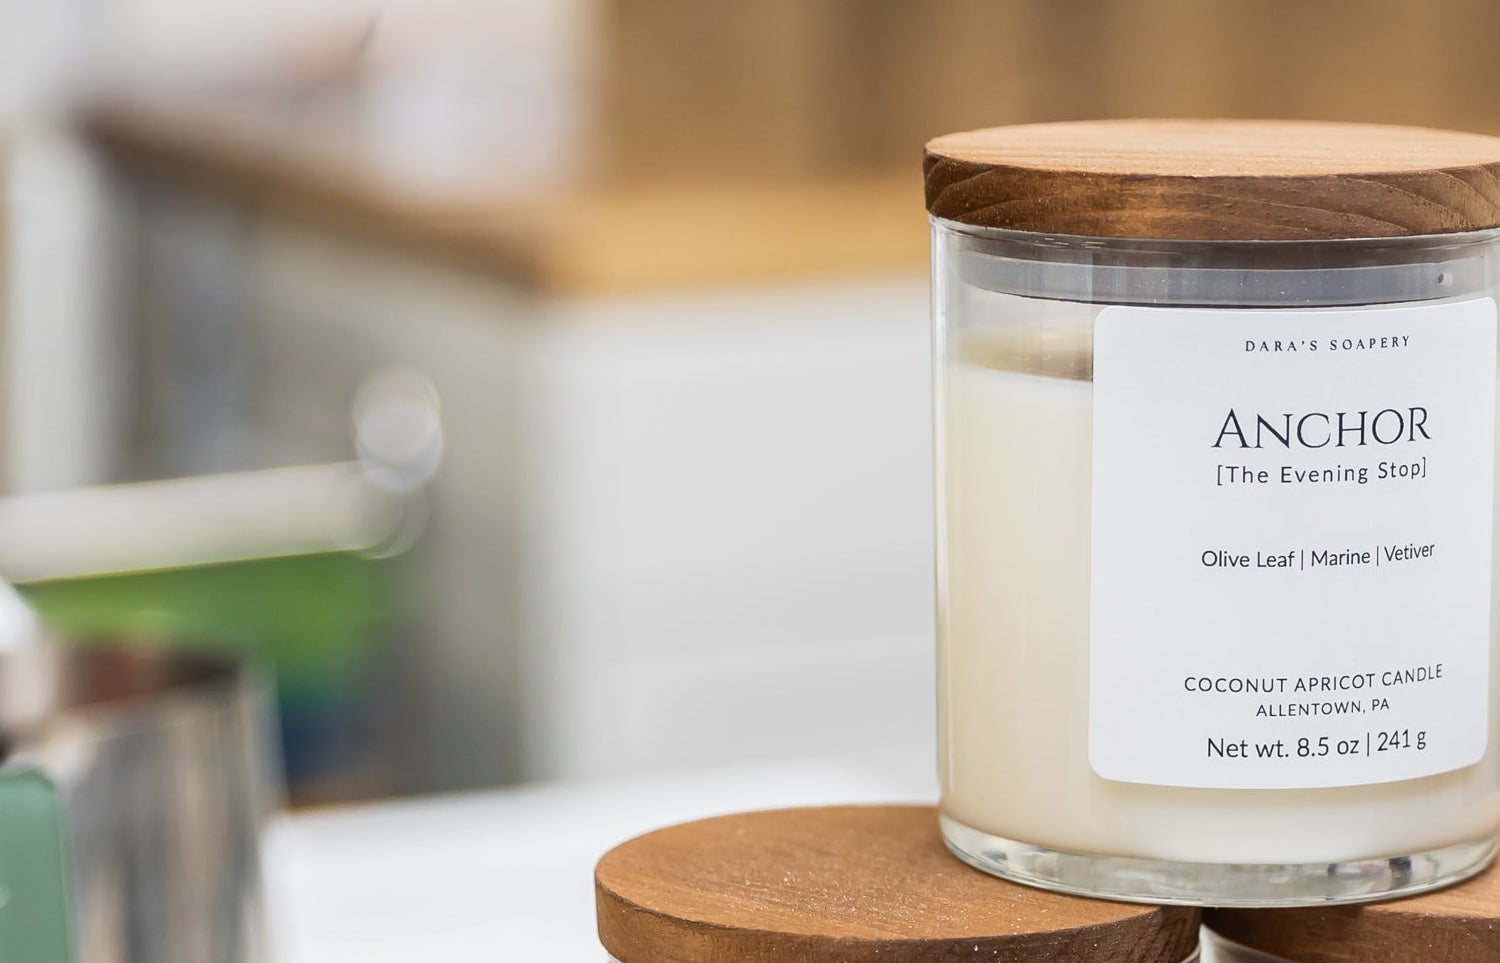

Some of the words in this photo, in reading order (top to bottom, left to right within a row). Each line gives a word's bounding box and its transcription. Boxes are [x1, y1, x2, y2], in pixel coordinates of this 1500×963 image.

[1245, 339, 1318, 352] DARA'S
[1329, 335, 1410, 351] SOAPERY
[1210, 406, 1432, 449] ANCHOR
[1217, 464, 1269, 487] [The
[1280, 464, 1369, 485] Evening
[1377, 456, 1427, 480] Stop]
[1201, 549, 1251, 568] Olive
[1256, 550, 1296, 568] Leaf
[1311, 548, 1371, 567] Marine
[1383, 542, 1436, 562] Vetiver
[1184, 676, 1288, 694] COCONUT
[1293, 672, 1376, 693] APRICOT
[1381, 663, 1443, 687] CANDLE
[1255, 699, 1366, 718] ALLENTOWN,
[1371, 697, 1390, 712] PA
[1207, 737, 1249, 759] Net
[1254, 739, 1290, 759] wt.
[1296, 736, 1330, 758] 8.5
[1336, 739, 1360, 756] oz
[1376, 728, 1411, 752] 241
[1416, 731, 1427, 751] g
